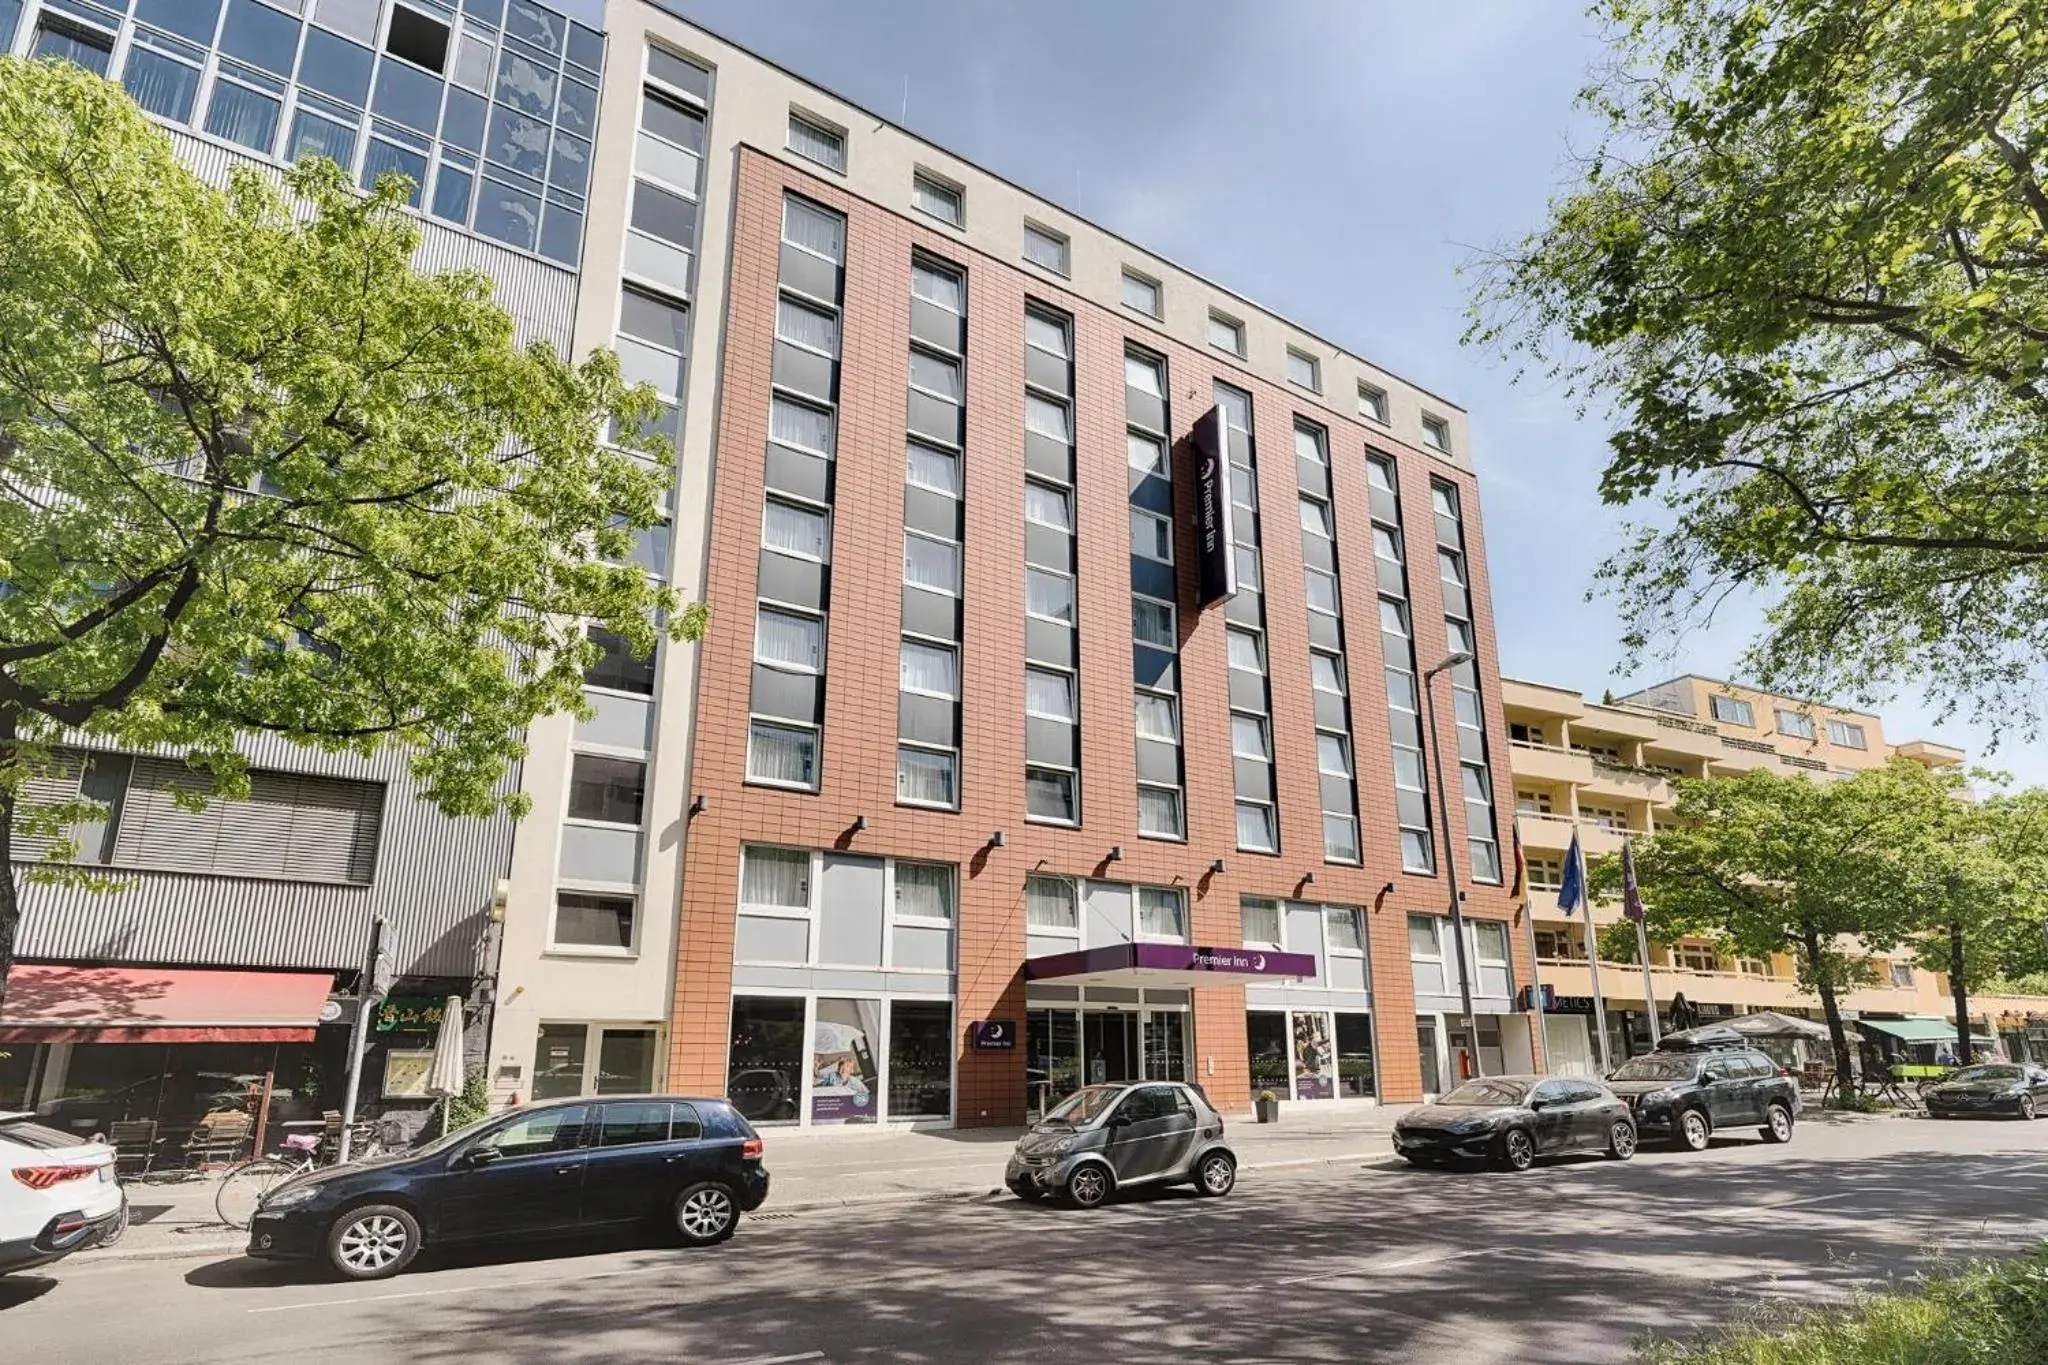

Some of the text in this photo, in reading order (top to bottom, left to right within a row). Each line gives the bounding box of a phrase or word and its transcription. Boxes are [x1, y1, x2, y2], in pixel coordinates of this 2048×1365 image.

[1203, 478, 1216, 553] Premier Inn
[1192, 952, 1249, 967] Premier Inn
